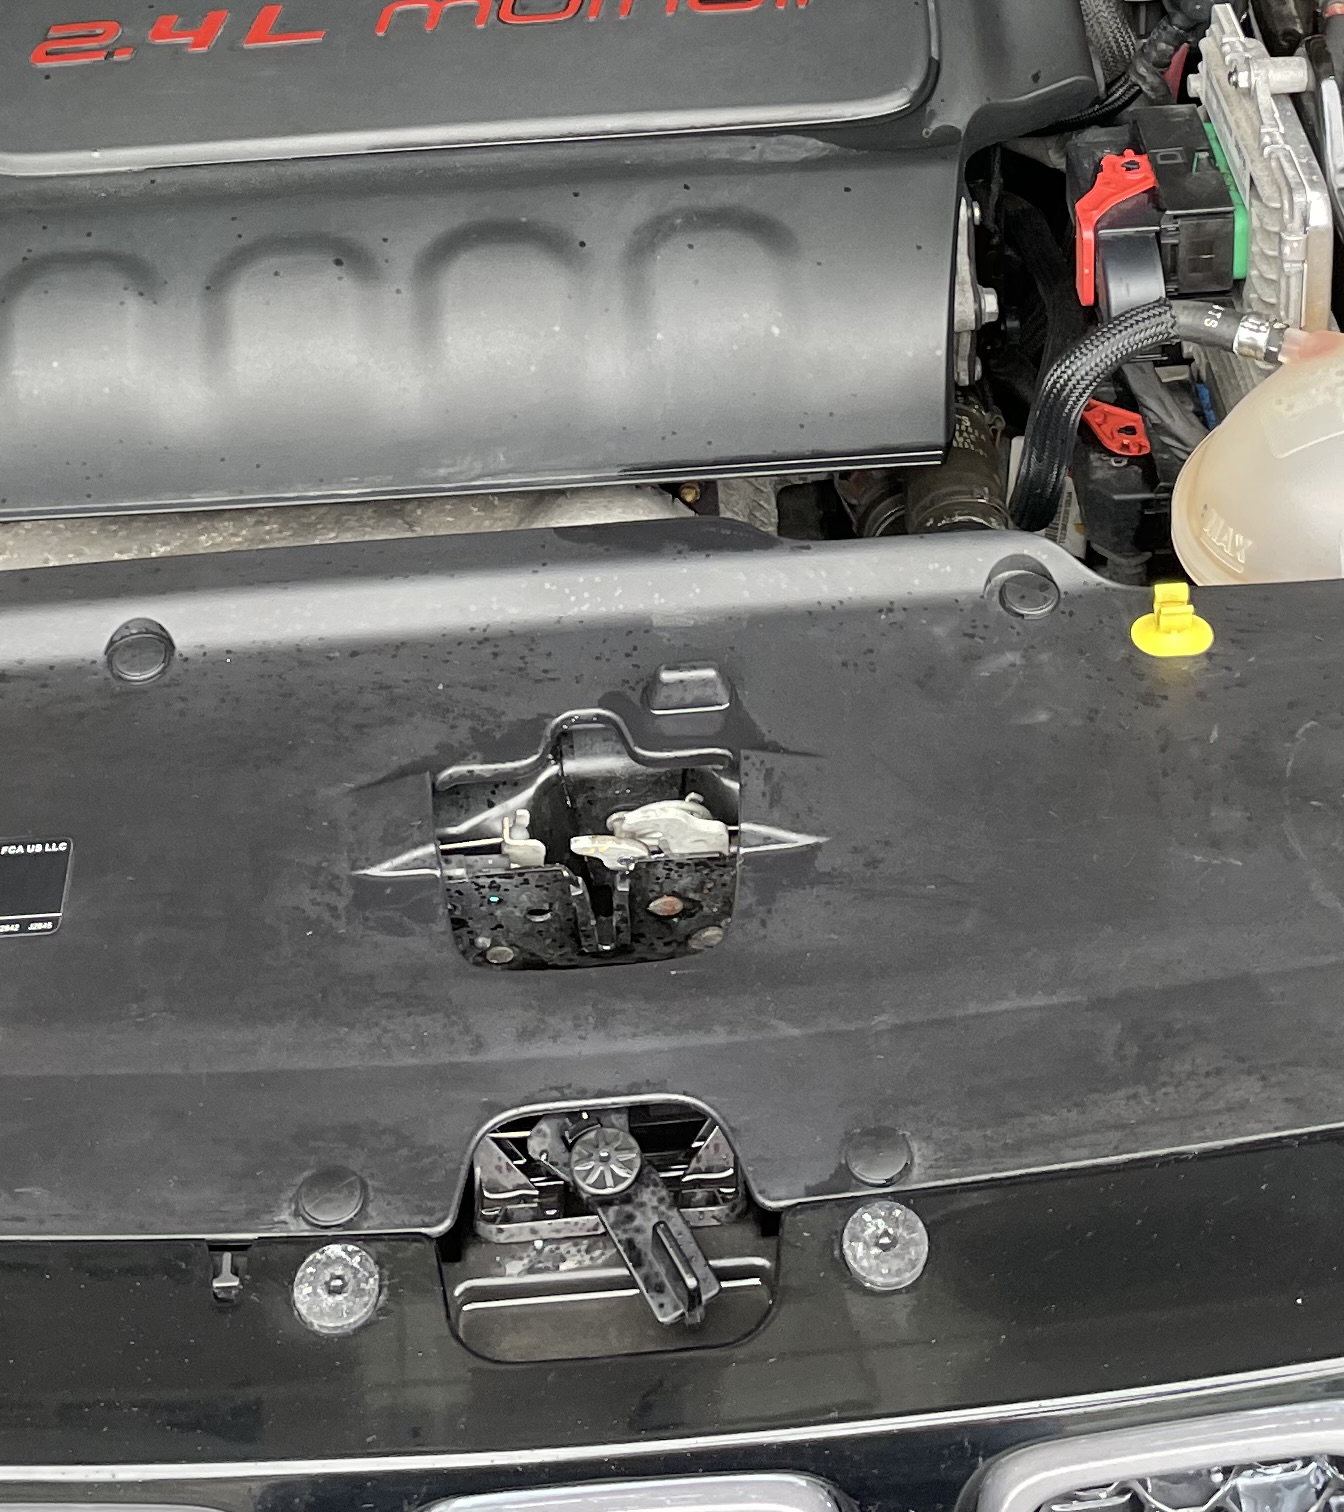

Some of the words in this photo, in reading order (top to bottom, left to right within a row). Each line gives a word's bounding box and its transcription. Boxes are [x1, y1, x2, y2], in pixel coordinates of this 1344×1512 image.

[1202, 508, 1254, 564] MAX
[0, 844, 24, 855] FCA
[44, 842, 68, 853] LLC
